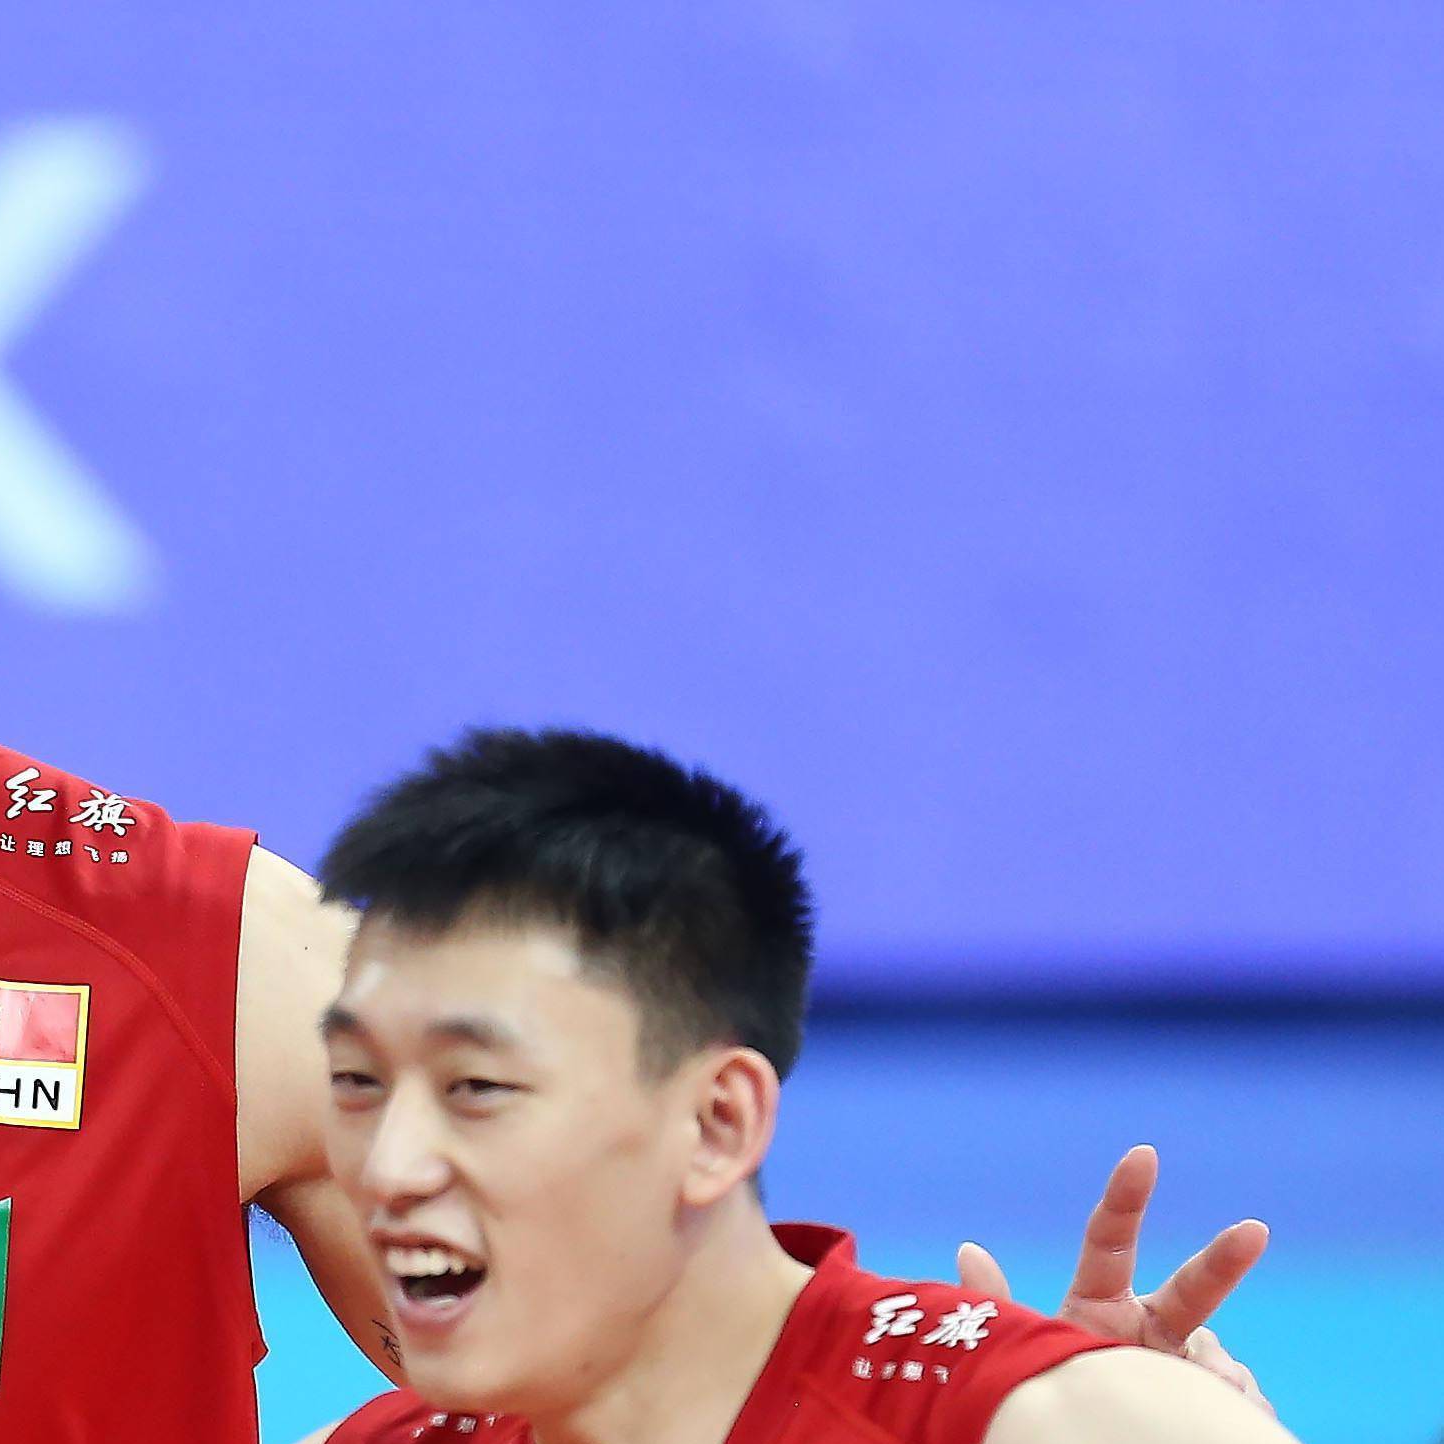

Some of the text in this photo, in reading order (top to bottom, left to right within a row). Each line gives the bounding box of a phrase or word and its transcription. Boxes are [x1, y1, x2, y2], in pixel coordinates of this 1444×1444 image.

[4, 767, 136, 836] 红旗
[0, 833, 129, 863] 让理想飞扬
[864, 1293, 999, 1350] 红旗
